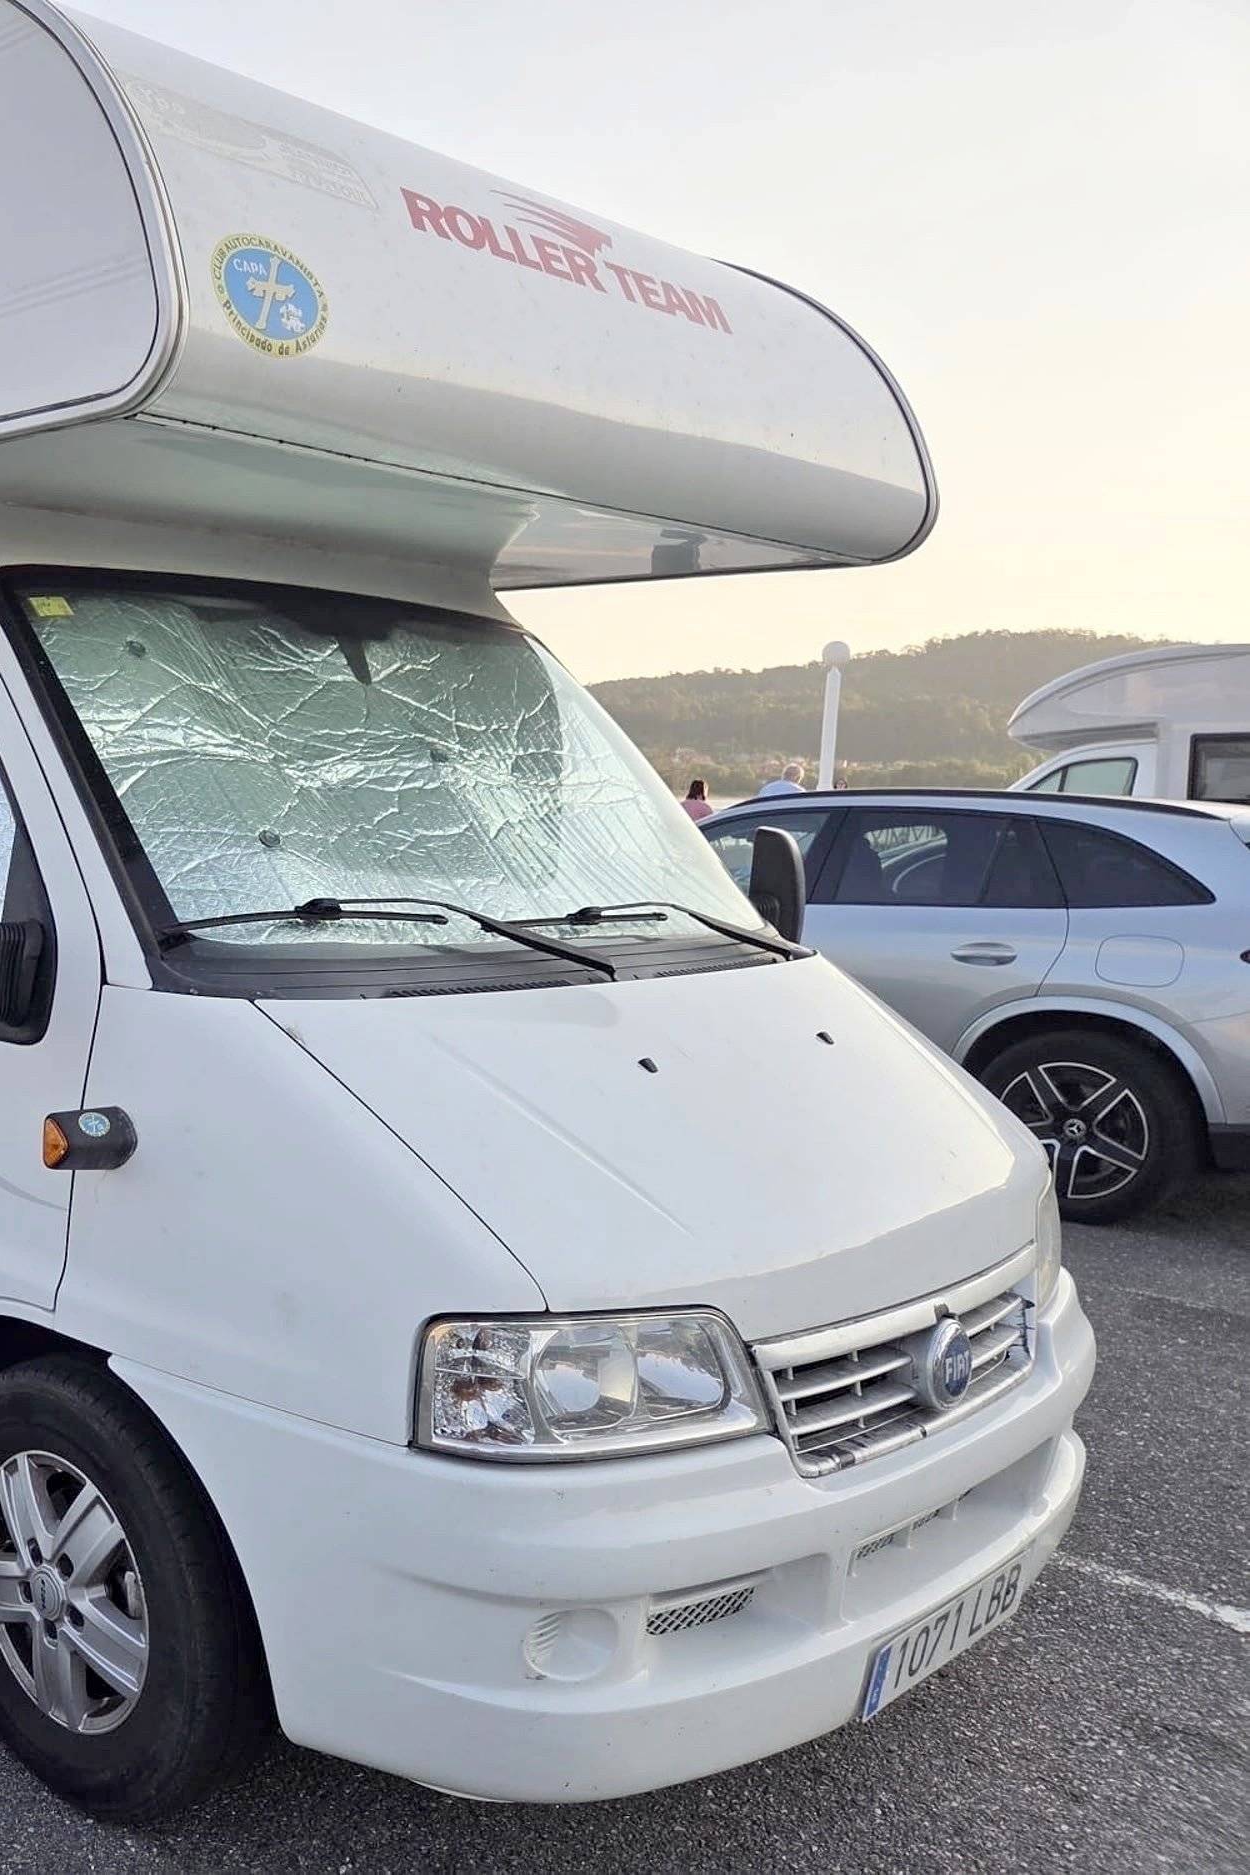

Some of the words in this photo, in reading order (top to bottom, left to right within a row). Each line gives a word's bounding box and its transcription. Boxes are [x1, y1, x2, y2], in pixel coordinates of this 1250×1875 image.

[400, 186, 607, 293] ROLLER
[604, 260, 733, 335] TEAM
[945, 1350, 970, 1384] FIAT
[893, 1600, 965, 1690] 1071
[968, 1563, 1022, 1638] LBB
